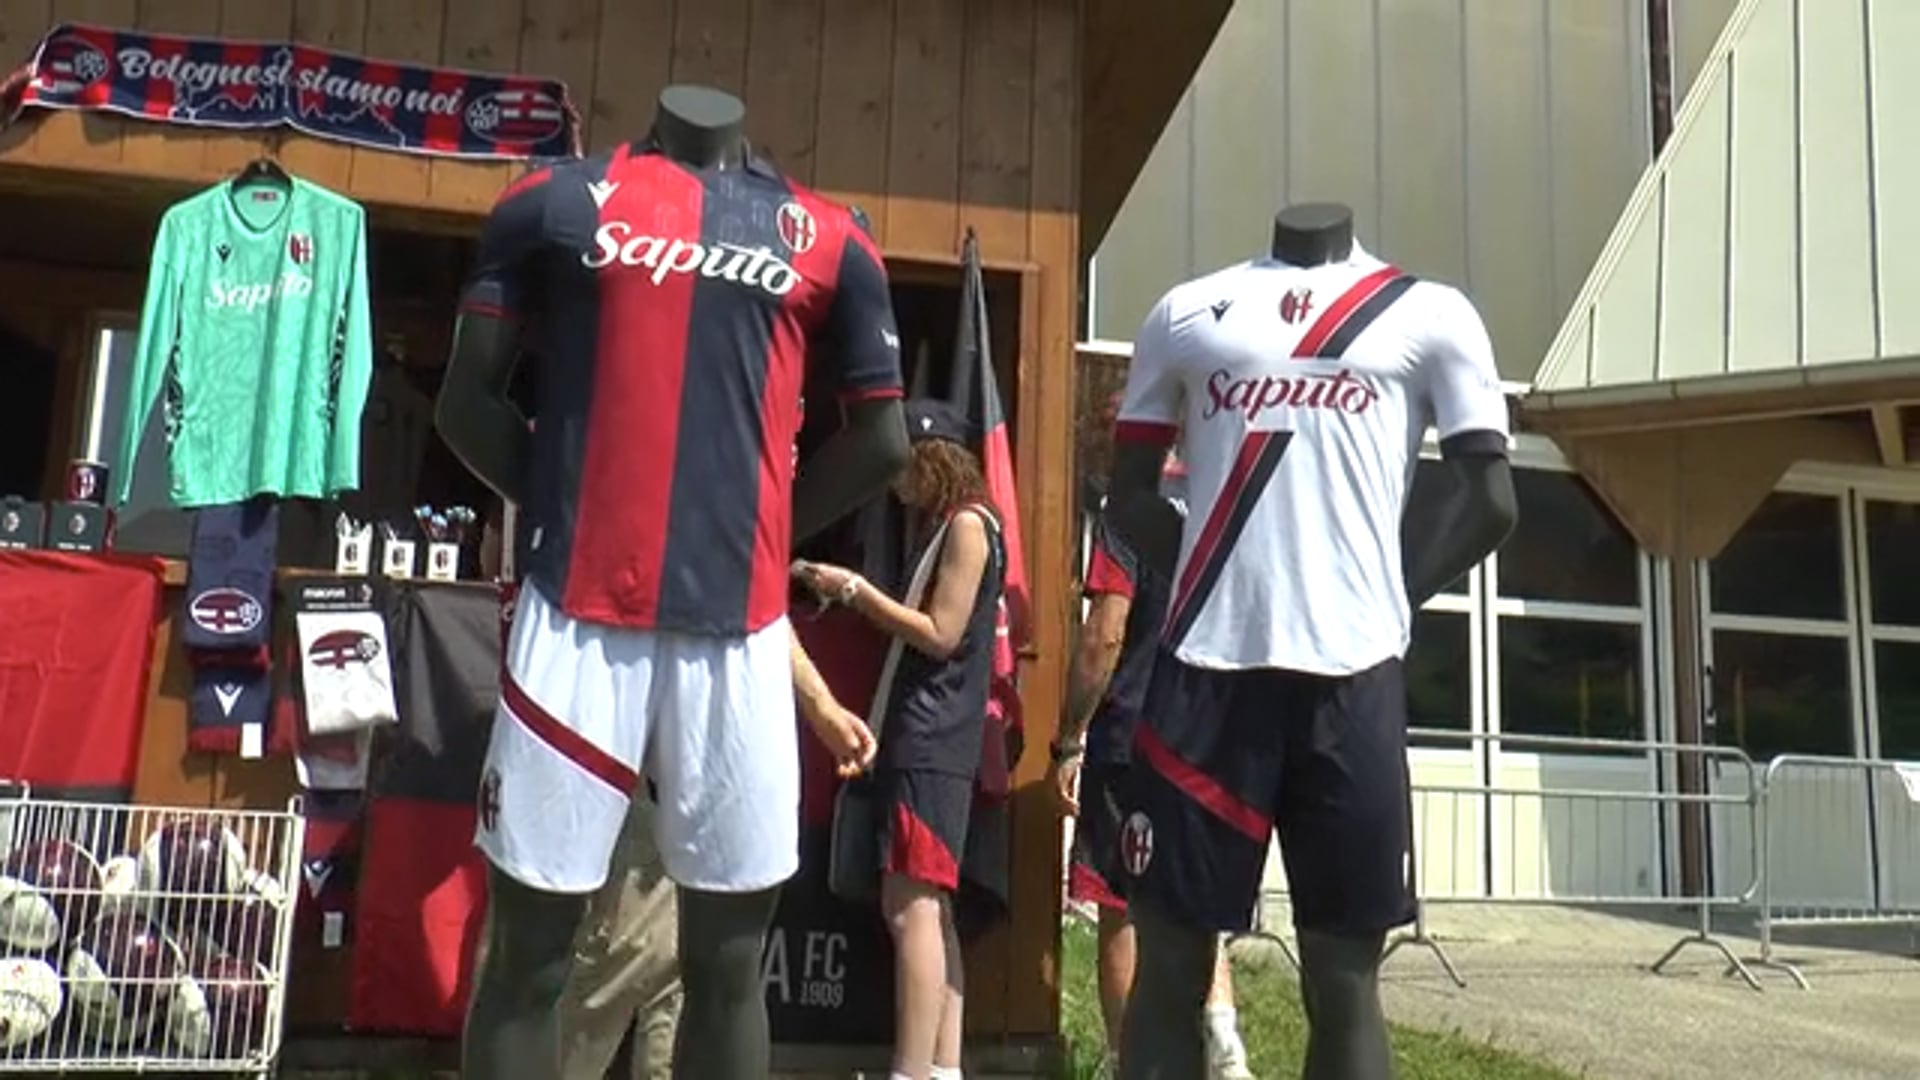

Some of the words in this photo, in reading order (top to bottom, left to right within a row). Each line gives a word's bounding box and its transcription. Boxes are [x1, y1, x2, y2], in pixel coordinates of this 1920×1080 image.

[117, 48, 293, 91] Bolognesi
[298, 68, 399, 107] siamo
[404, 89, 463, 115] noi
[582, 221, 802, 295] Saputo
[1204, 369, 1379, 421] Saputo
[803, 931, 848, 981] FC
